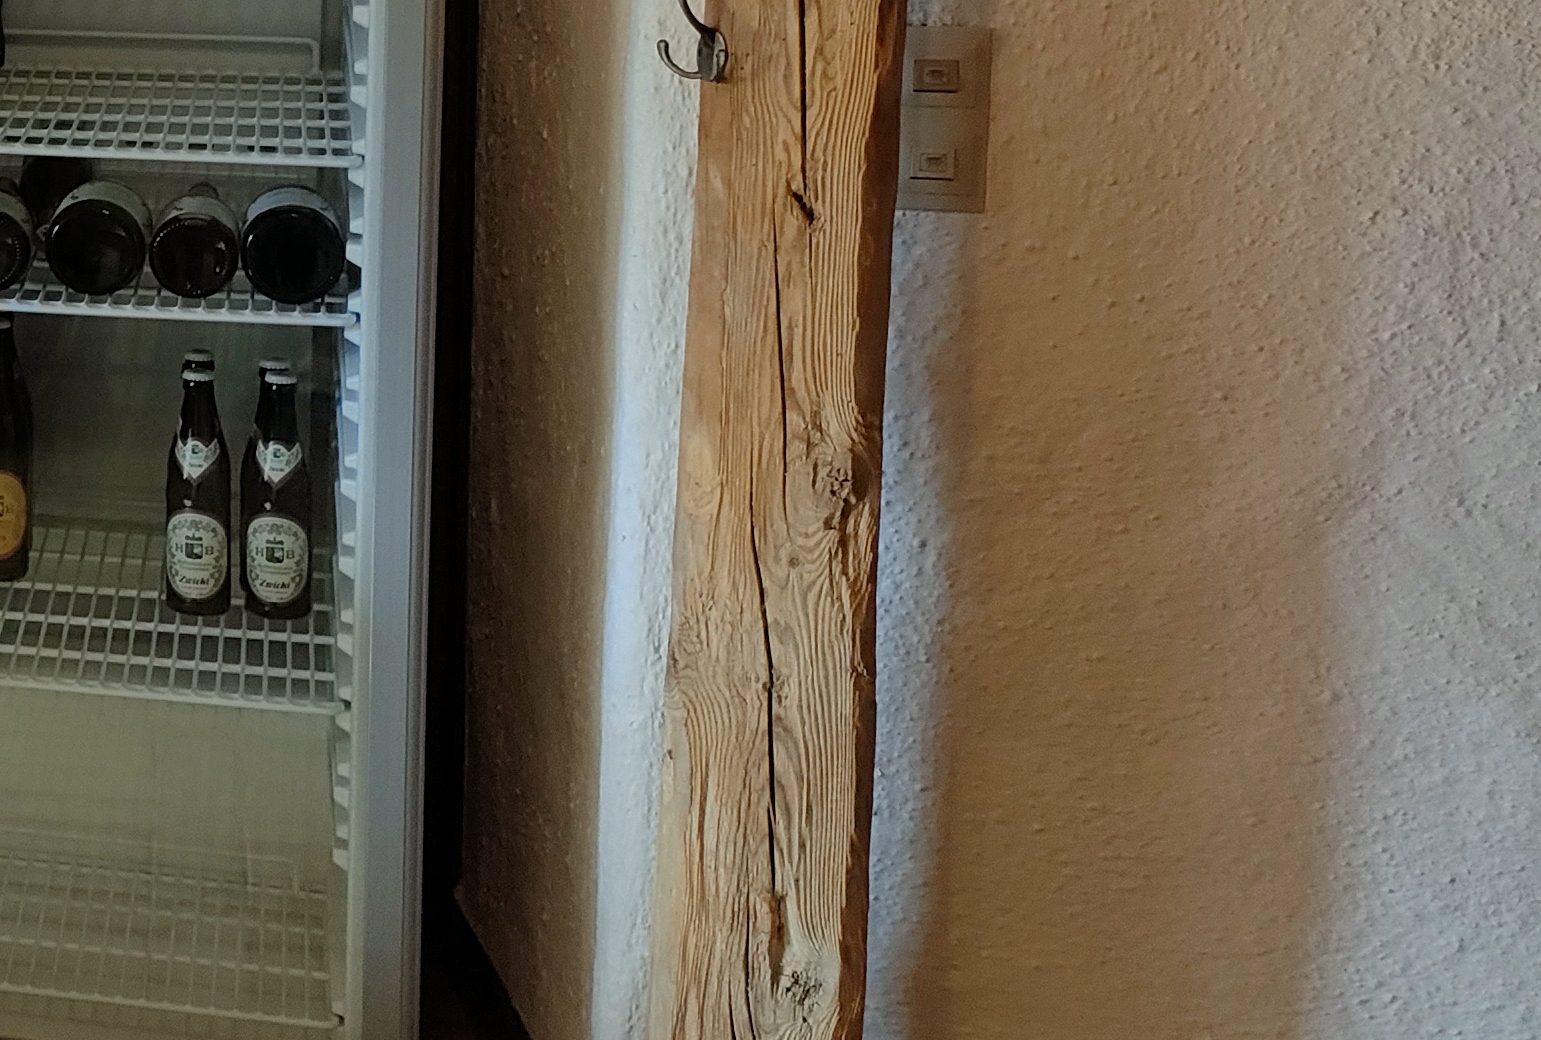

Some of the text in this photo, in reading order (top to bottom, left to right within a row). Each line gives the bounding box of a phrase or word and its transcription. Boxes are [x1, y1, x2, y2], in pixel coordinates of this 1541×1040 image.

[175, 543, 214, 555] H B
[255, 547, 295, 559] H B
